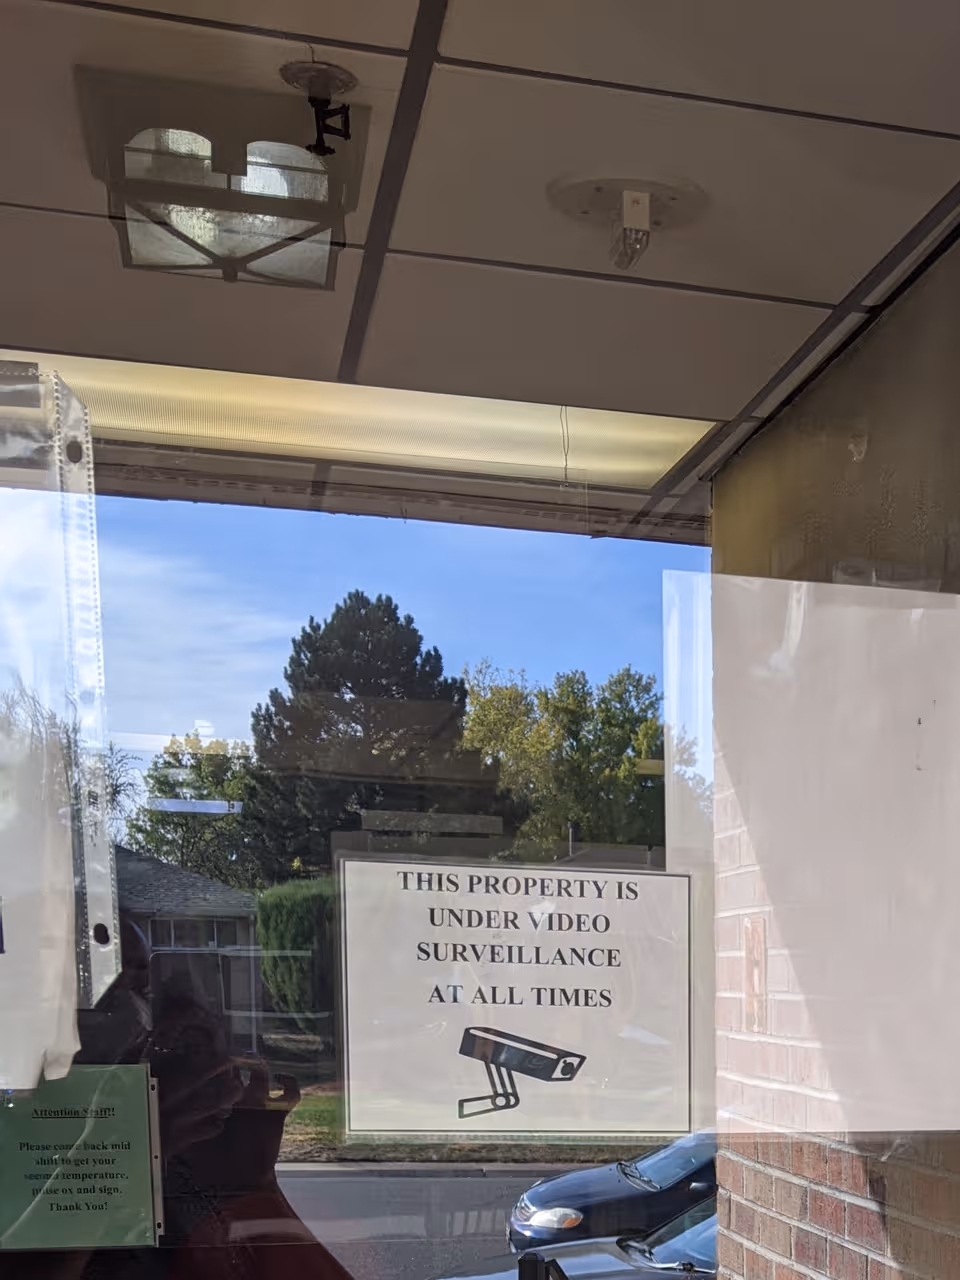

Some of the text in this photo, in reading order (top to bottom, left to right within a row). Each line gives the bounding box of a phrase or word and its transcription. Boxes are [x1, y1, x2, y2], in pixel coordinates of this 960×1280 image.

[397, 871, 638, 900] THIS PROPERTY IS
[427, 907, 610, 933] UNDER VIDEO
[417, 941, 621, 967] SURVEILLANCE
[427, 984, 612, 1008] AT ALL TIMES
[32, 1108, 80, 1117] Attention
[19, 1142, 52, 1151] Please
[83, 1141, 109, 1151] back
[111, 1141, 131, 1150] mid
[35, 1157, 58, 1166] shift
[73, 1158, 90, 1167] get
[92, 1158, 117, 1167] your
[76, 1185, 96, 1194] and
[98, 1185, 123, 1196] sign.
[49, 1202, 108, 1211] Thank You!
